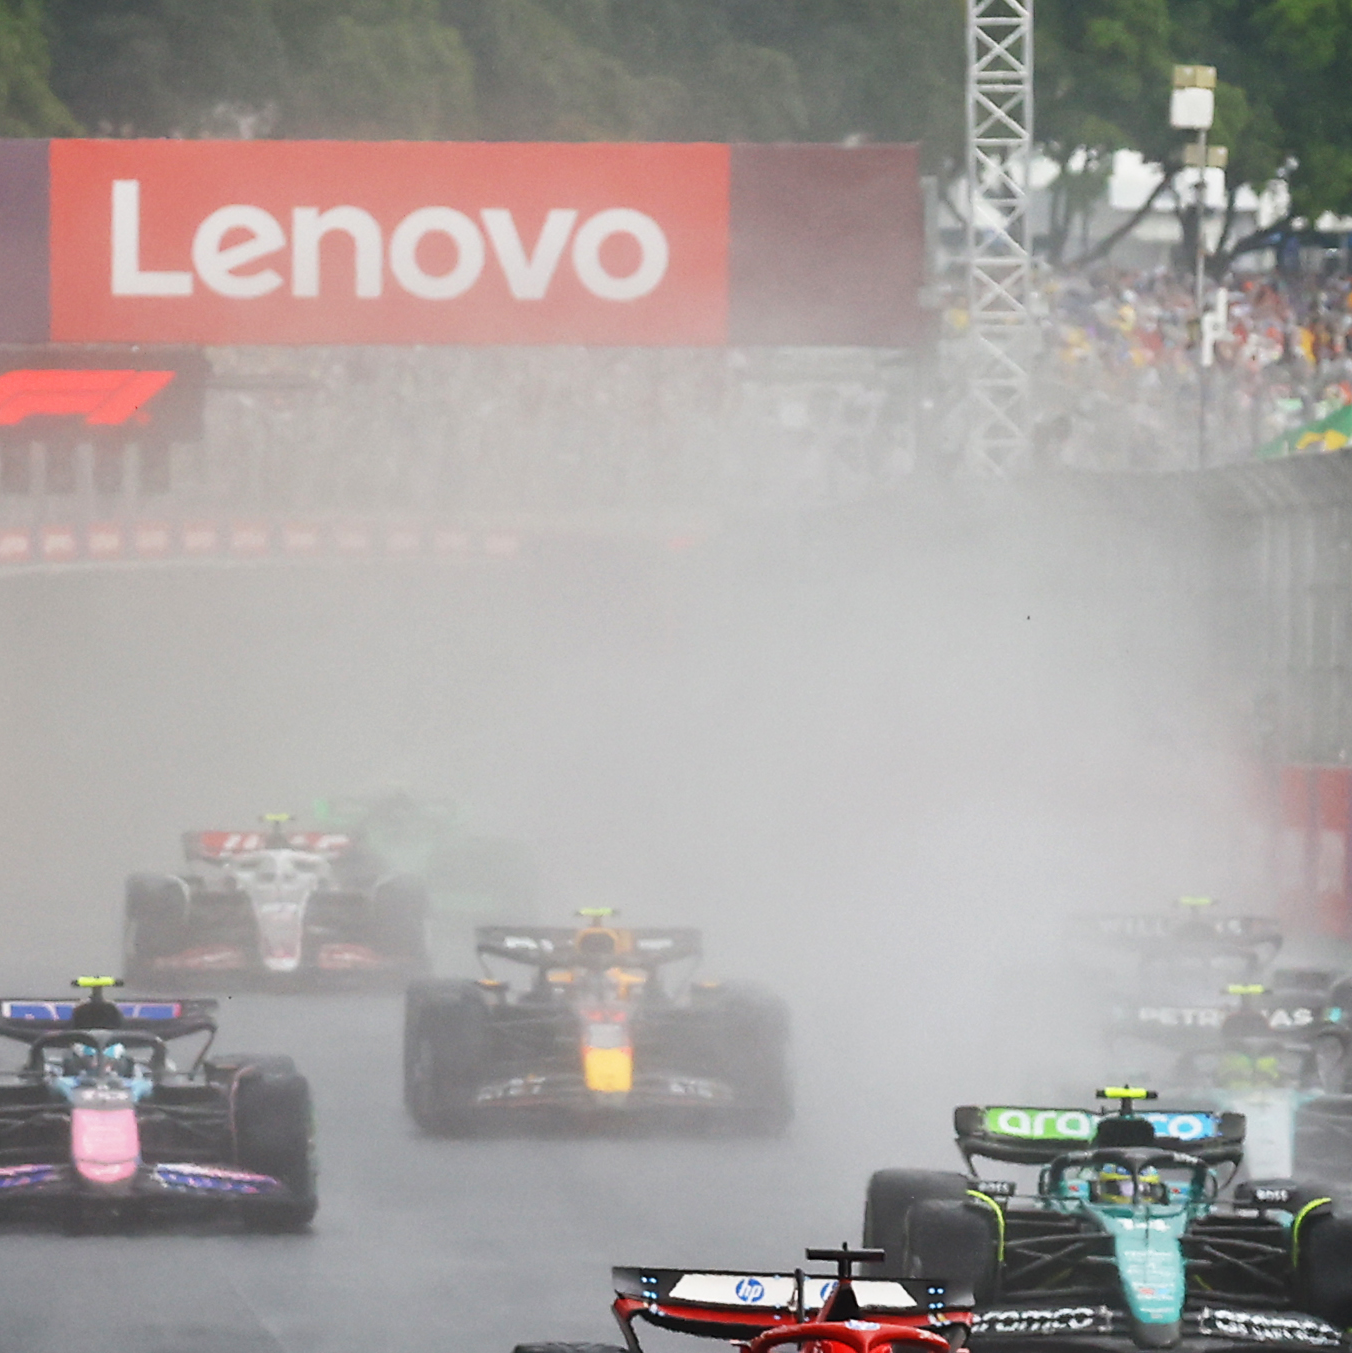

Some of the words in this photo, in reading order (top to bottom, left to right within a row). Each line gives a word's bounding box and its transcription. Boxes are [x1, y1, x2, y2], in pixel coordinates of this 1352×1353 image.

[111, 179, 670, 302] Lenovo
[1138, 1006, 1314, 1029] PETRAS
[998, 1109, 1203, 1141] araco
